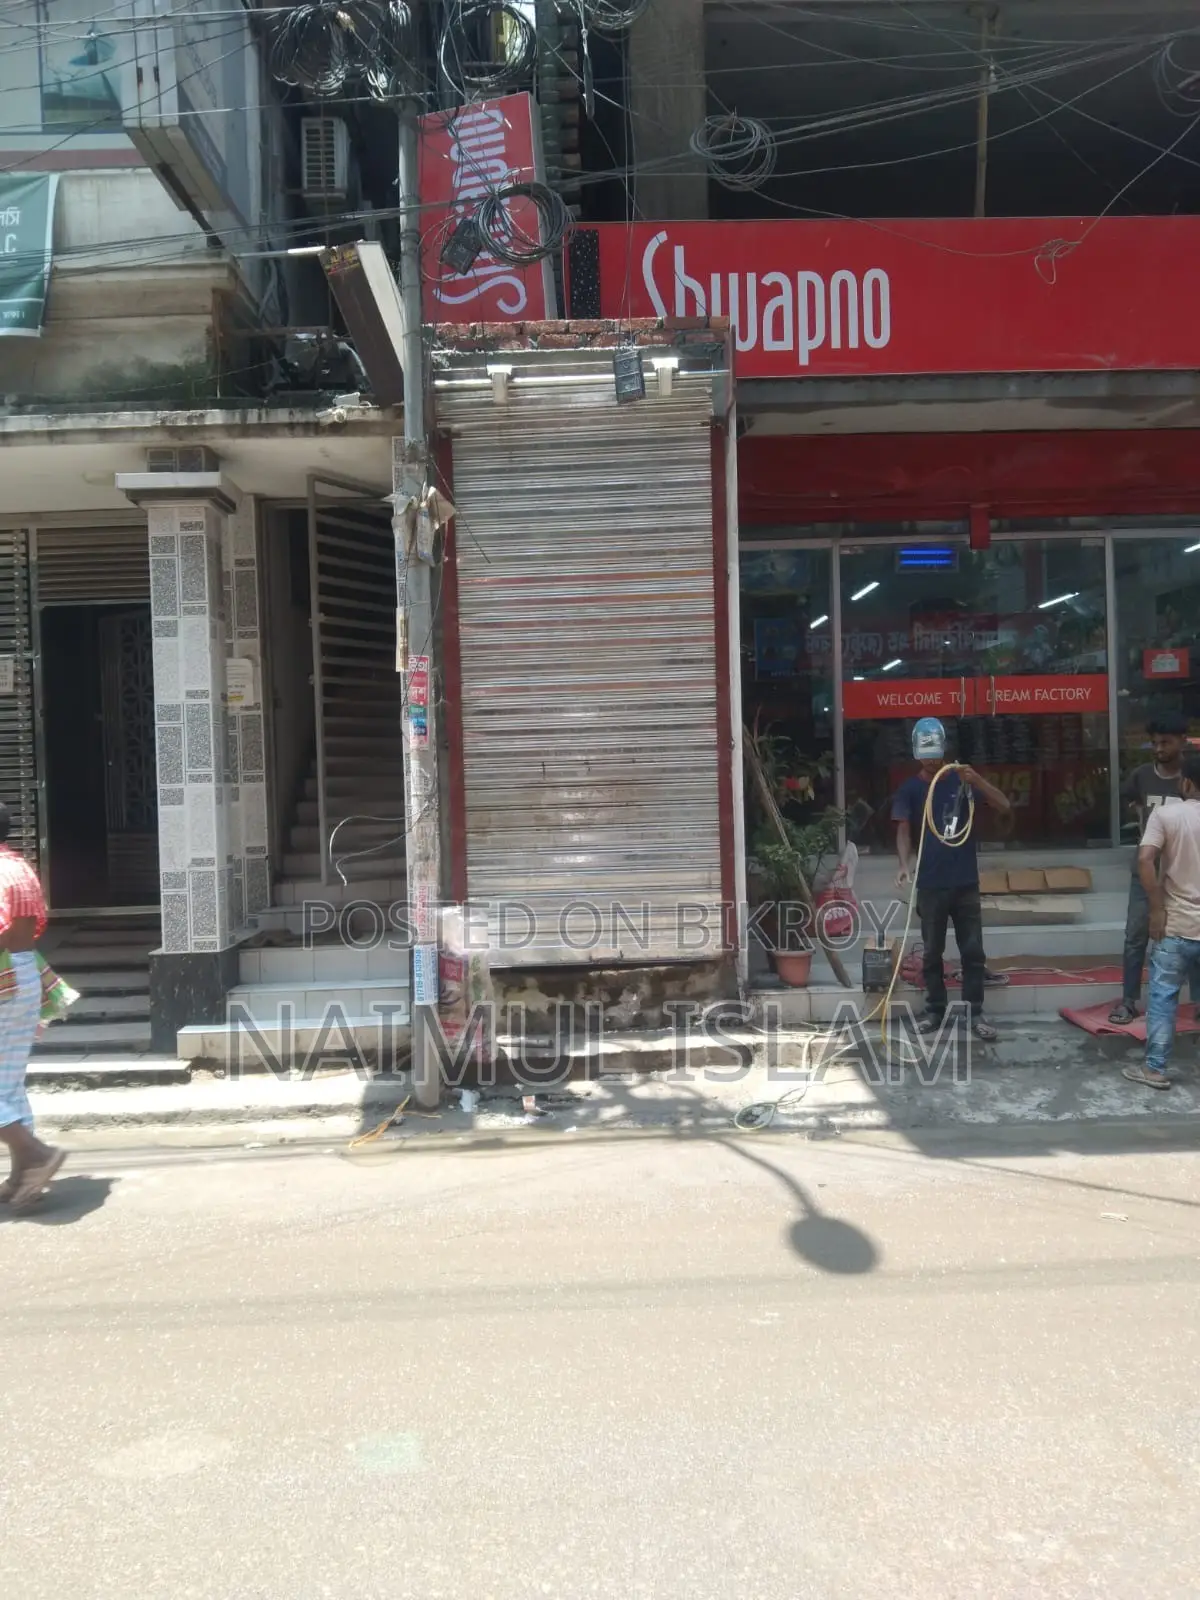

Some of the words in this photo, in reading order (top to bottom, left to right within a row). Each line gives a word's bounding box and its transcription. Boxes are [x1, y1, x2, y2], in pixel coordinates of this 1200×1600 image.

[877, 692, 942, 706] WELCOME
[948, 691, 967, 704] TO
[1034, 687, 1092, 701] FACTORY
